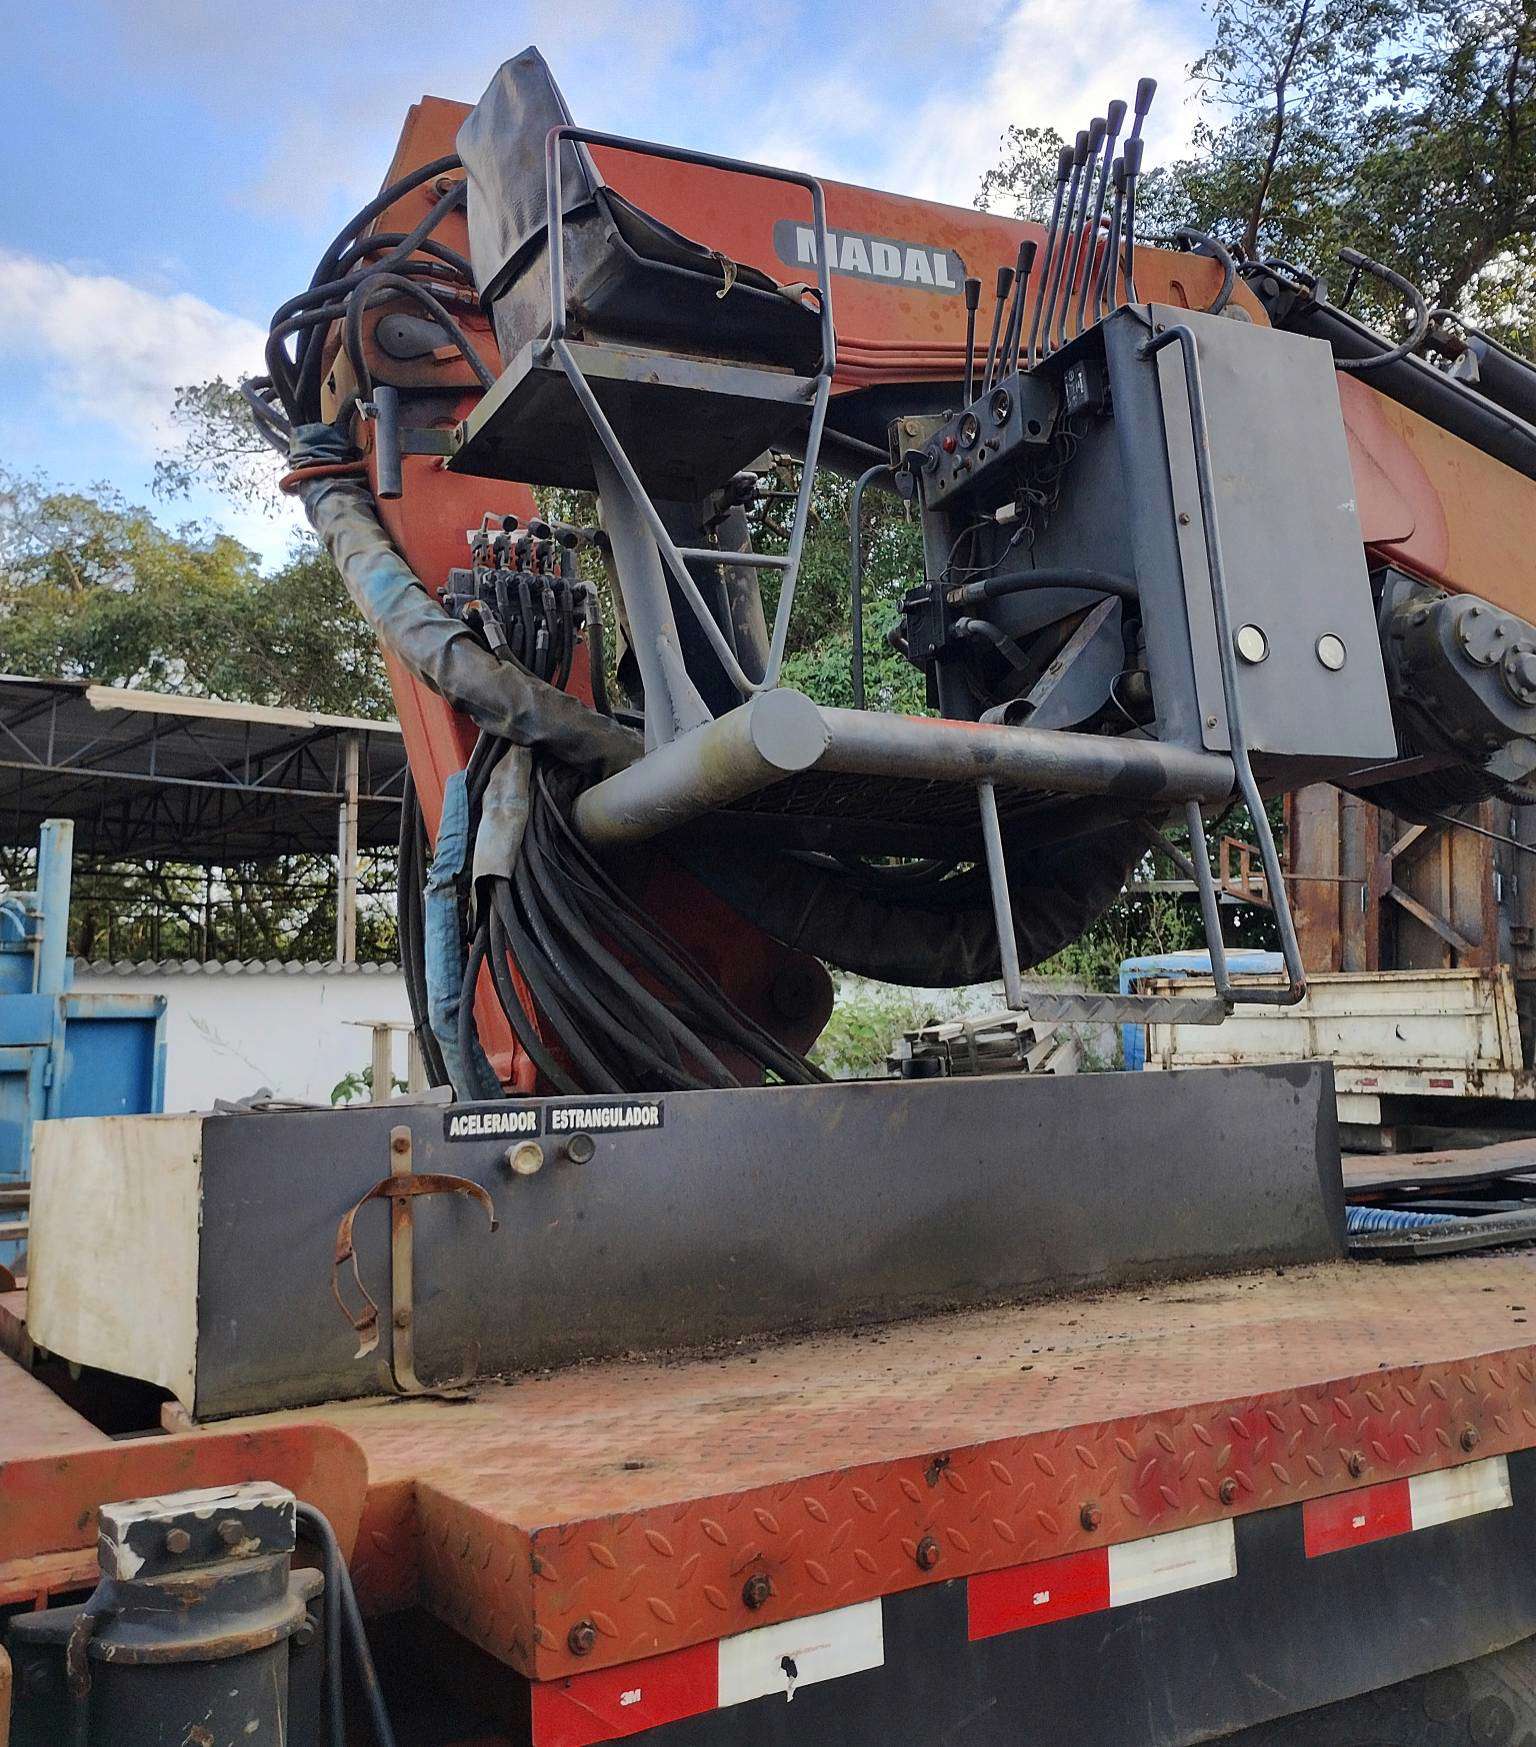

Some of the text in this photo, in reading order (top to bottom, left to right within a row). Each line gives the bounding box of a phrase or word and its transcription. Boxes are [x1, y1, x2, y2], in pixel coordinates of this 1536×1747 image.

[796, 226, 956, 289] MADAL
[450, 1111, 537, 1137] ACELERADOR
[552, 1106, 660, 1130] ESTRANGULADOR
[1033, 1591, 1050, 1605] 3M
[620, 1688, 641, 1706] 3M
